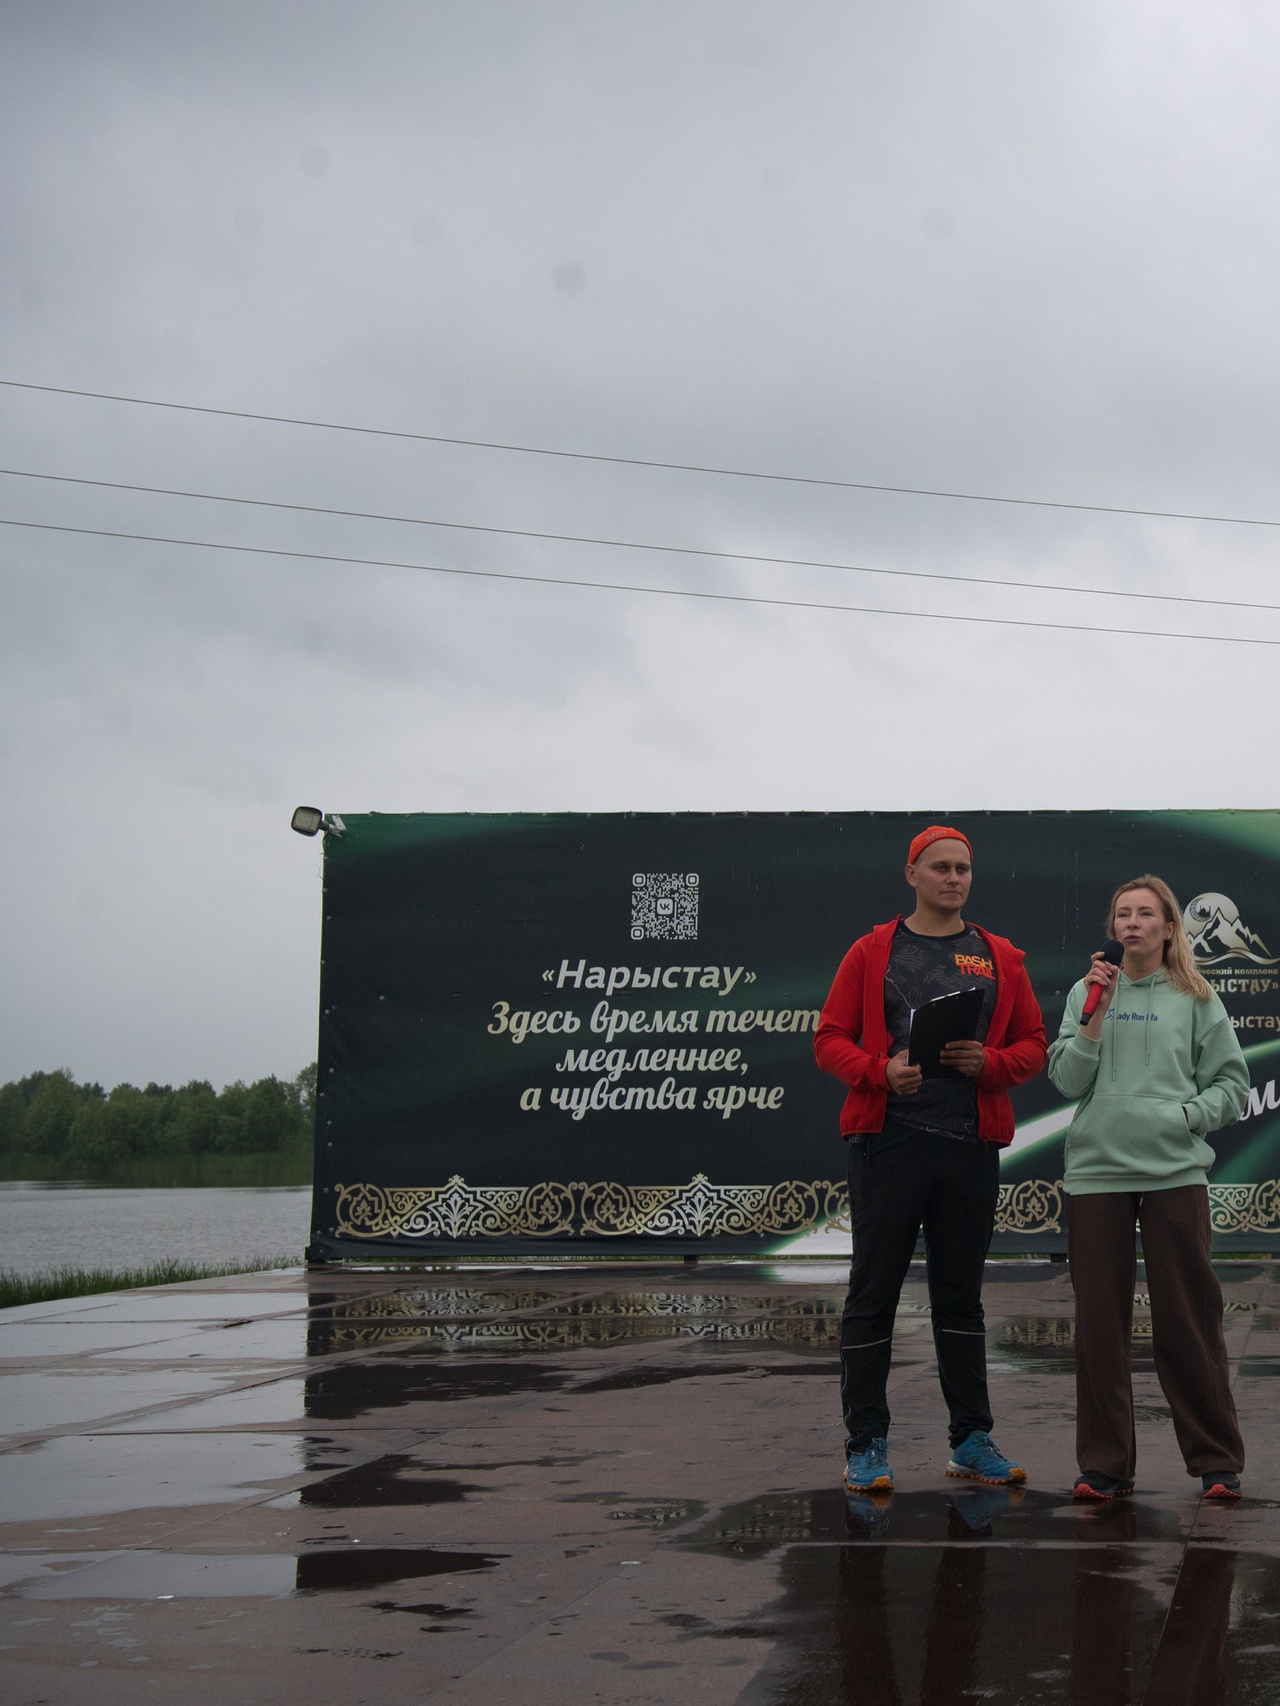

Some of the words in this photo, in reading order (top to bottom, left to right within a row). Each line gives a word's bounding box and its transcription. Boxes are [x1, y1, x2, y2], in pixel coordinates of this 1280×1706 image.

[541, 959, 757, 996] «Нарыстау»
[955, 953, 993, 970] BASH
[960, 964, 996, 980] TRAIL
[1210, 978, 1279, 993] ЫСТАУ»
[487, 1001, 581, 1044] Здесь
[589, 1000, 698, 1043] время
[705, 1008, 821, 1033] течет
[555, 1046, 749, 1081] медленнее,
[519, 1087, 541, 1111] а
[550, 1076, 695, 1121] чувства
[702, 1085, 785, 1120] ярче
